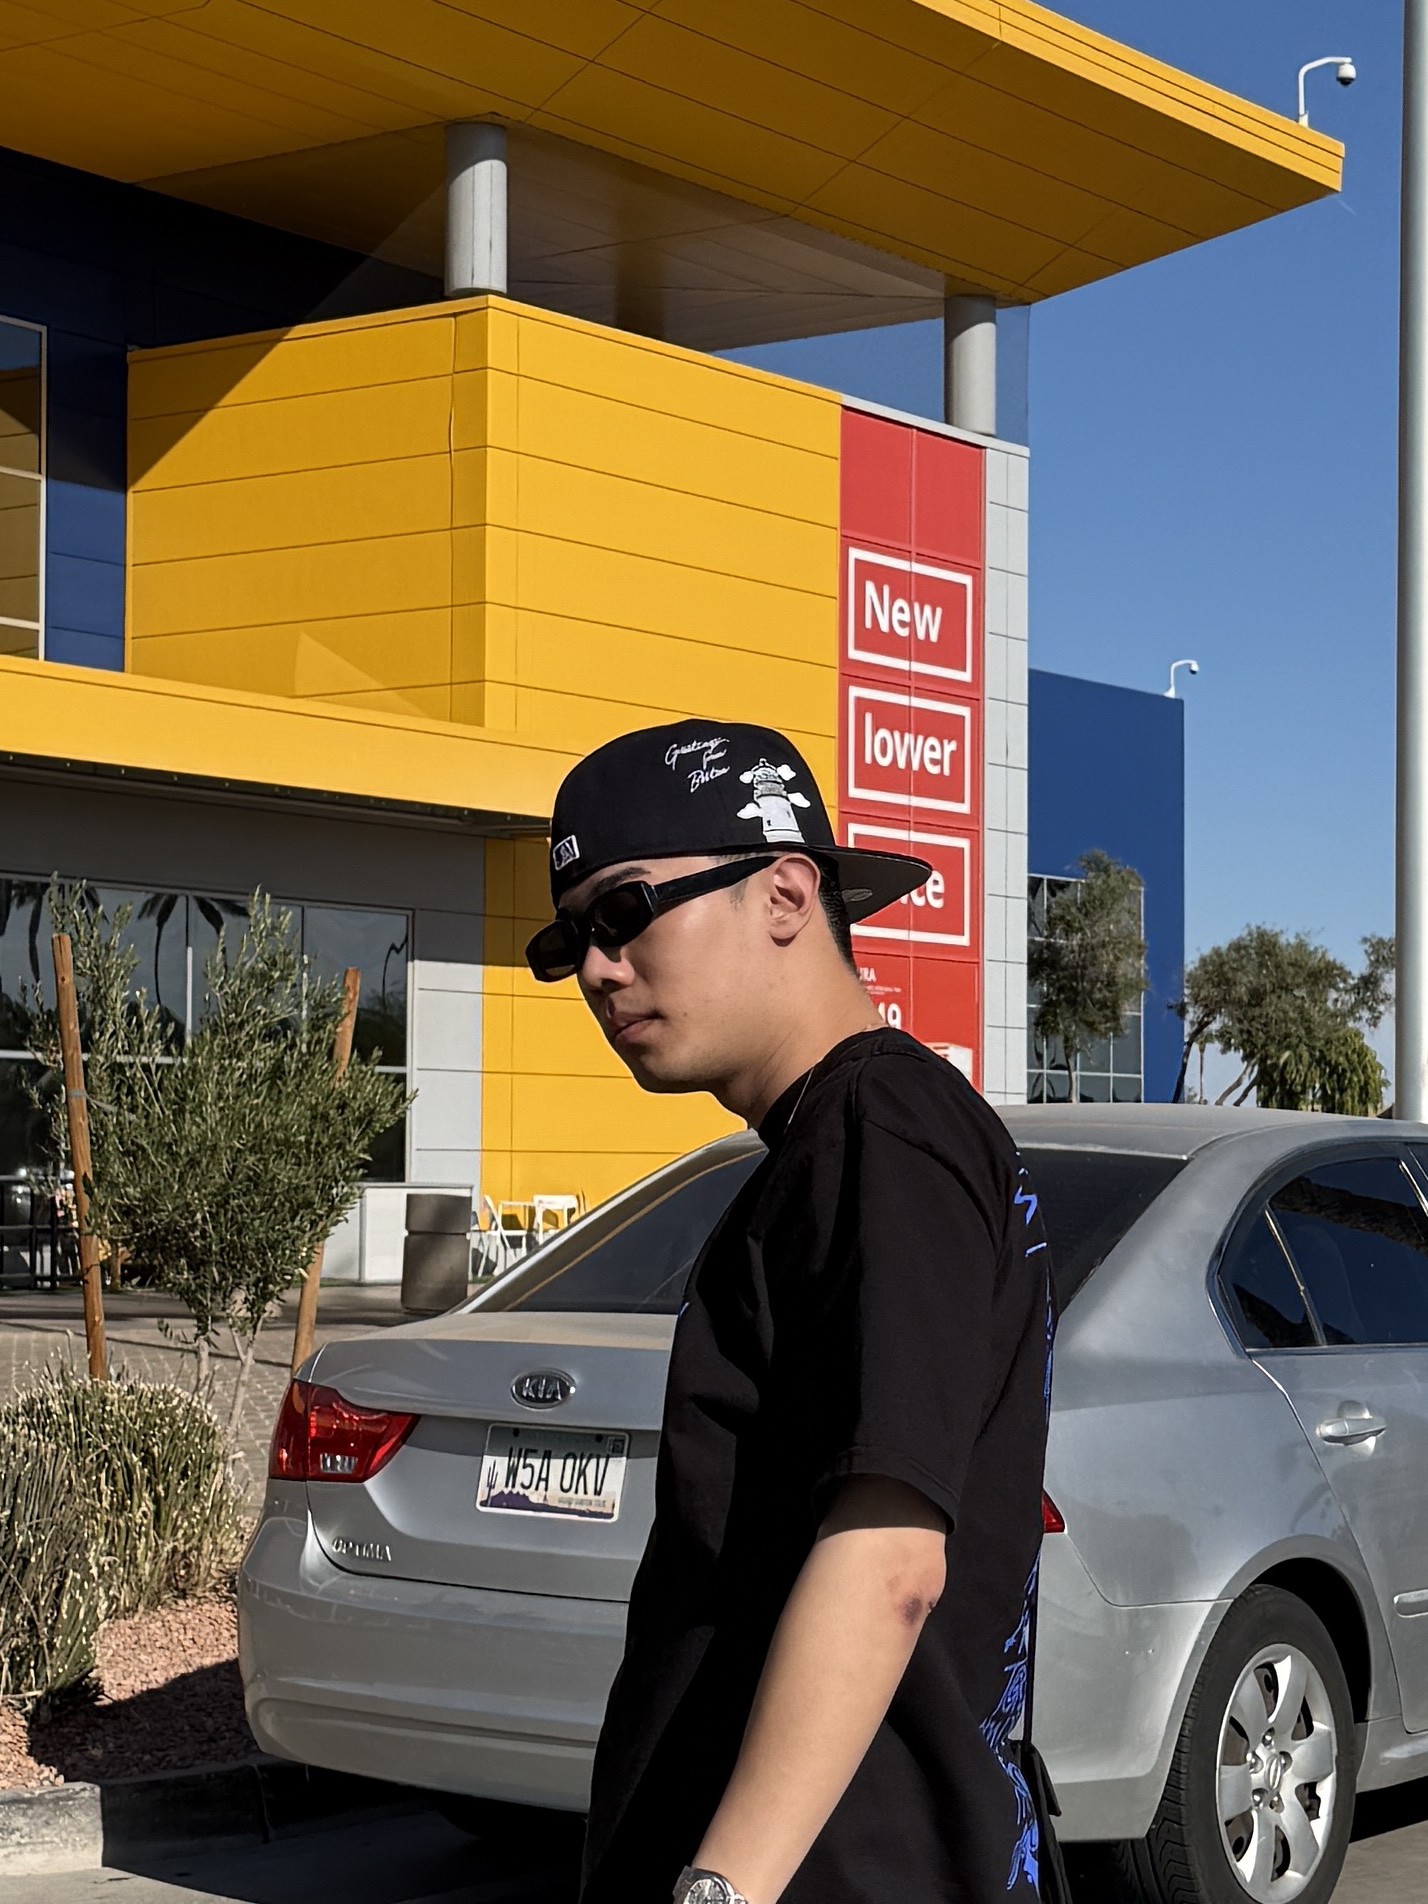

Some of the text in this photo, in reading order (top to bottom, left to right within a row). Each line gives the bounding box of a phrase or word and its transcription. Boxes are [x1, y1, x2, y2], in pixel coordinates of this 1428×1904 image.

[865, 580, 943, 643] New
[864, 712, 958, 777] lower
[522, 1377, 562, 1401] KIA
[504, 1446, 553, 1493] W5A
[332, 1538, 392, 1563] OPTIMA
